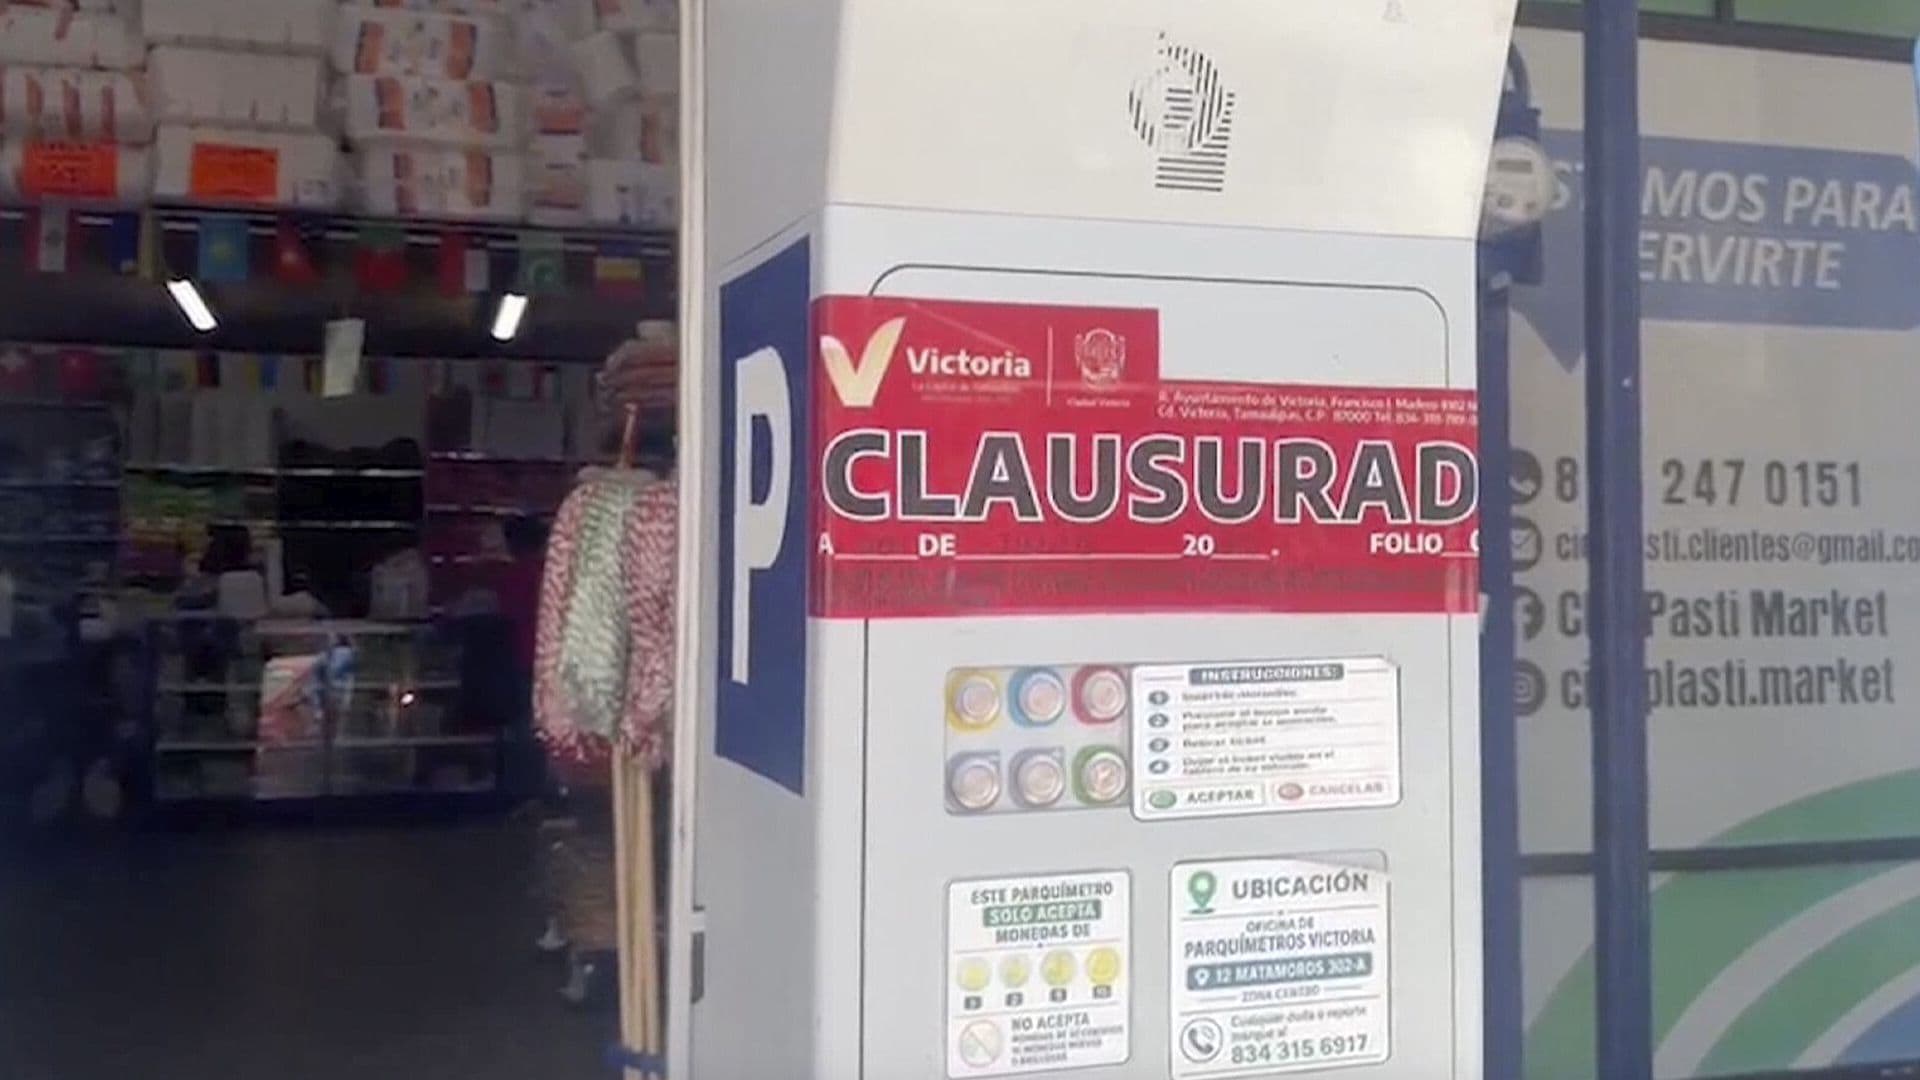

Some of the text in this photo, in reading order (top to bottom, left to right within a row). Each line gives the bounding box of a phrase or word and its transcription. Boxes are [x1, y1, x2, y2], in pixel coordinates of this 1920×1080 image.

[1783, 176, 1918, 232] PARA
[1639, 230, 1846, 290] ERVIRTE
[906, 347, 1032, 378] Victoria
[822, 427, 1479, 525] CLAUSURAD
[1661, 458, 1862, 508] 247 0151
[731, 347, 792, 686] P
[817, 531, 835, 556] A
[917, 532, 957, 558] DE
[1182, 533, 1216, 557] 20
[1369, 531, 1444, 555] FOLIO
[1750, 587, 1889, 639] Market
[1186, 781, 1385, 805] ACEPTAR CANCELAR
[970, 881, 1114, 905] ESTE PARQUÍMETRO
[1231, 867, 1370, 900] UBICACIÓN
[988, 903, 1097, 925] SOLO ACEPTA
[1245, 916, 1315, 932] OFICINA DE
[995, 923, 1091, 944] MONEDAS DE
[1183, 927, 1376, 959] PARQUÍMETROS VICTORIA
[1235, 960, 1325, 983] MATAMOROS
[1010, 1011, 1090, 1032] NO ACEPTA
[1230, 1032, 1369, 1065] 834 315 6917
